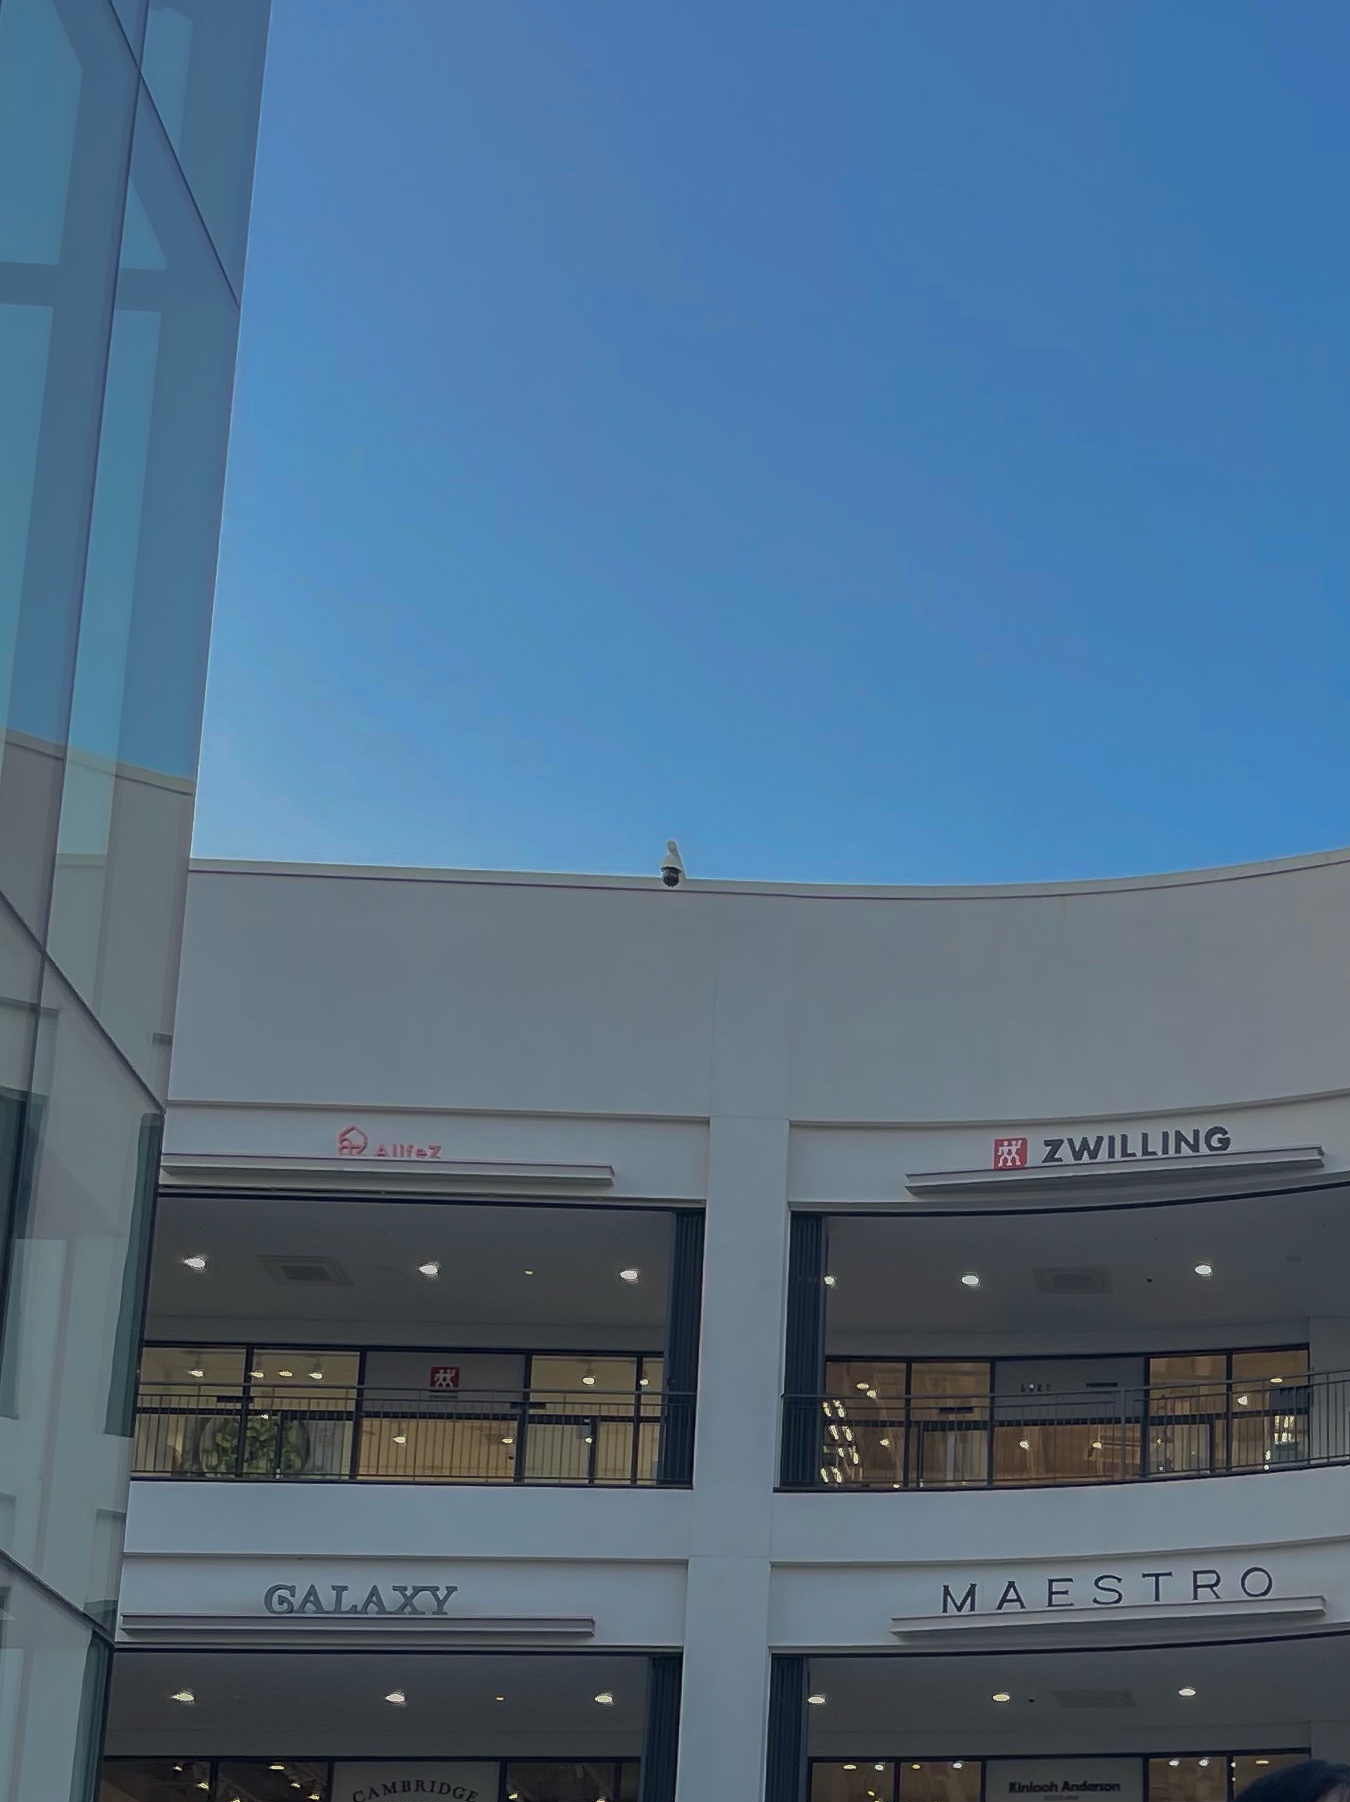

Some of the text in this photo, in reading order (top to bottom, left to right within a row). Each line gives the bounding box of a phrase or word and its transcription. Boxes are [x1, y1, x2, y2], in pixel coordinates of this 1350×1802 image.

[1041, 1125, 1231, 1164] ZWILLING
[264, 1584, 458, 1615] GALAXY
[942, 1567, 1273, 1614] MAESTRO
[1062, 1780, 1121, 1792] Anderson
